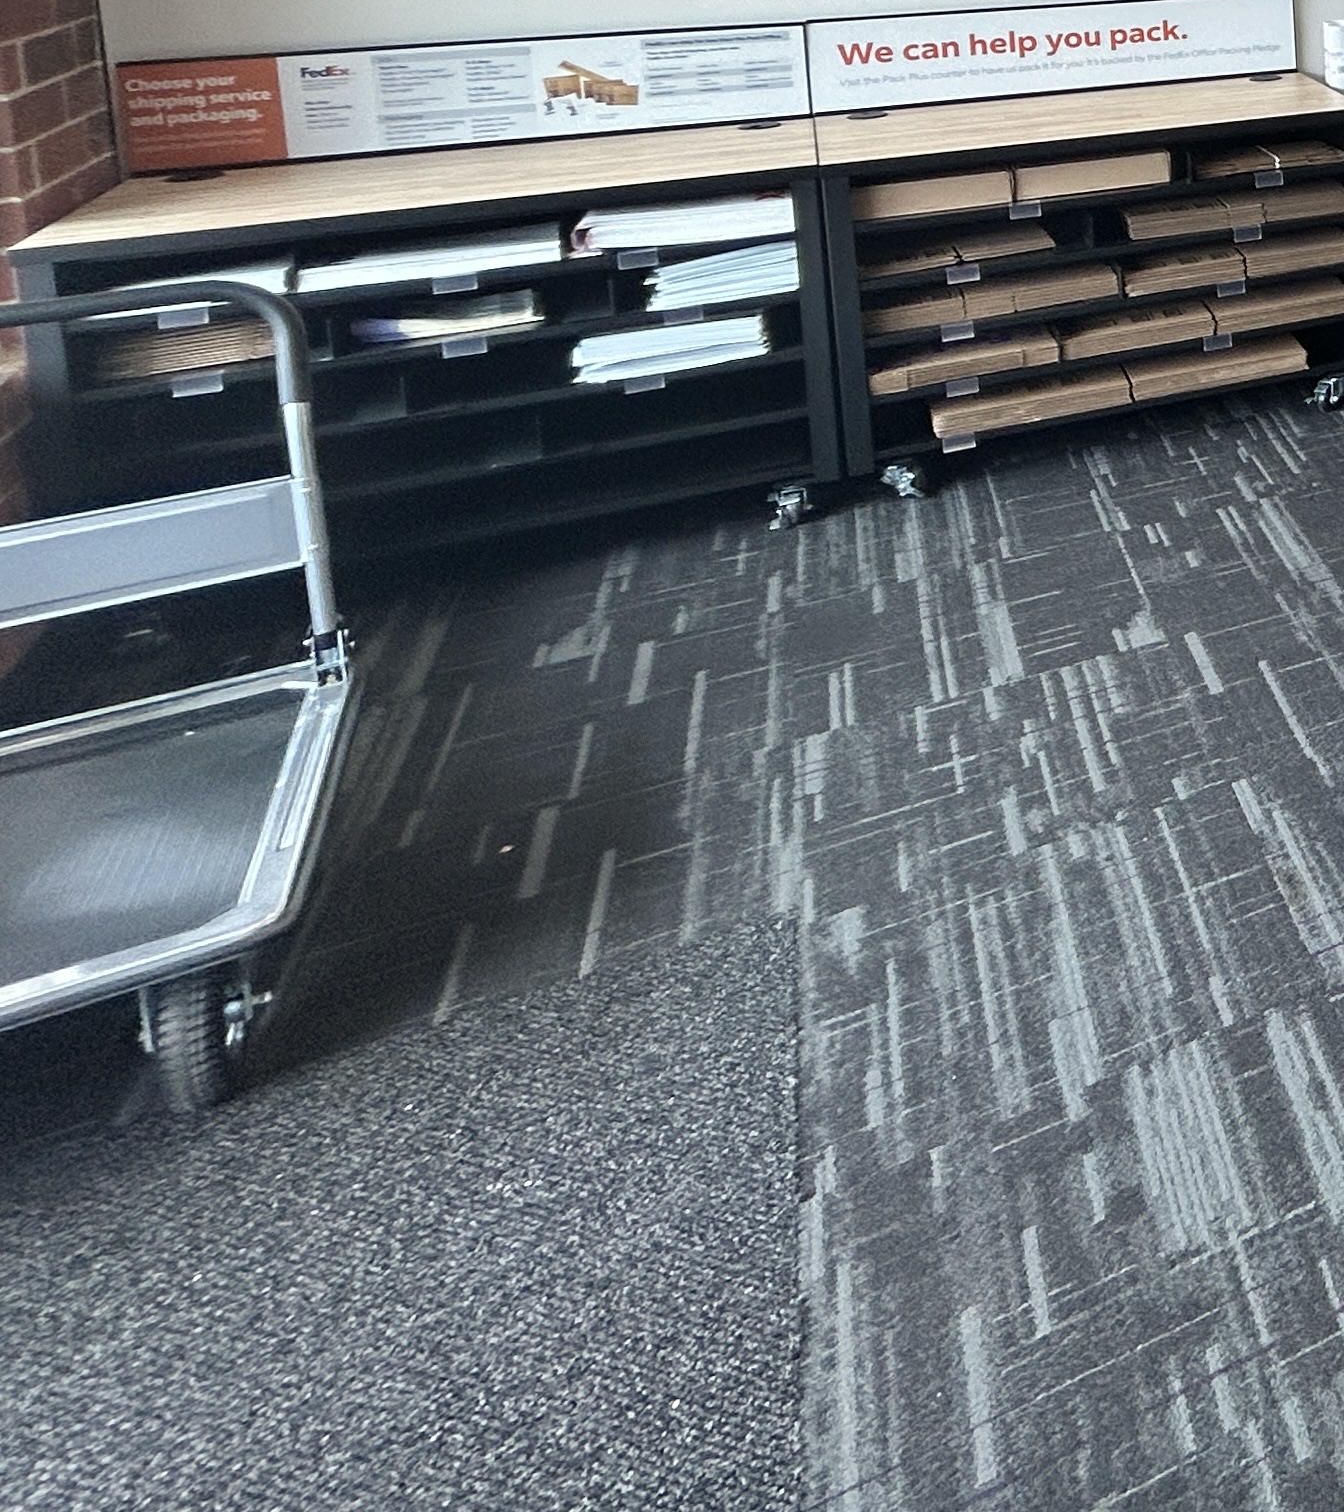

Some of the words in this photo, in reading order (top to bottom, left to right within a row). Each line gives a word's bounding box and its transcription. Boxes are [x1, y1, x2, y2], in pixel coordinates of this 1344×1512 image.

[836, 41, 894, 66] We
[902, 39, 961, 62] can
[968, 30, 1038, 59] help
[1044, 29, 1102, 57] you
[1109, 19, 1189, 51] pack.
[1163, 50, 1190, 61] FedEx
[300, 65, 351, 79] FedEx
[124, 76, 192, 92] Choose
[196, 74, 237, 90] your
[127, 92, 207, 110] shipping
[209, 87, 273, 102] service
[129, 112, 164, 127] and
[166, 106, 264, 127] packaging.
